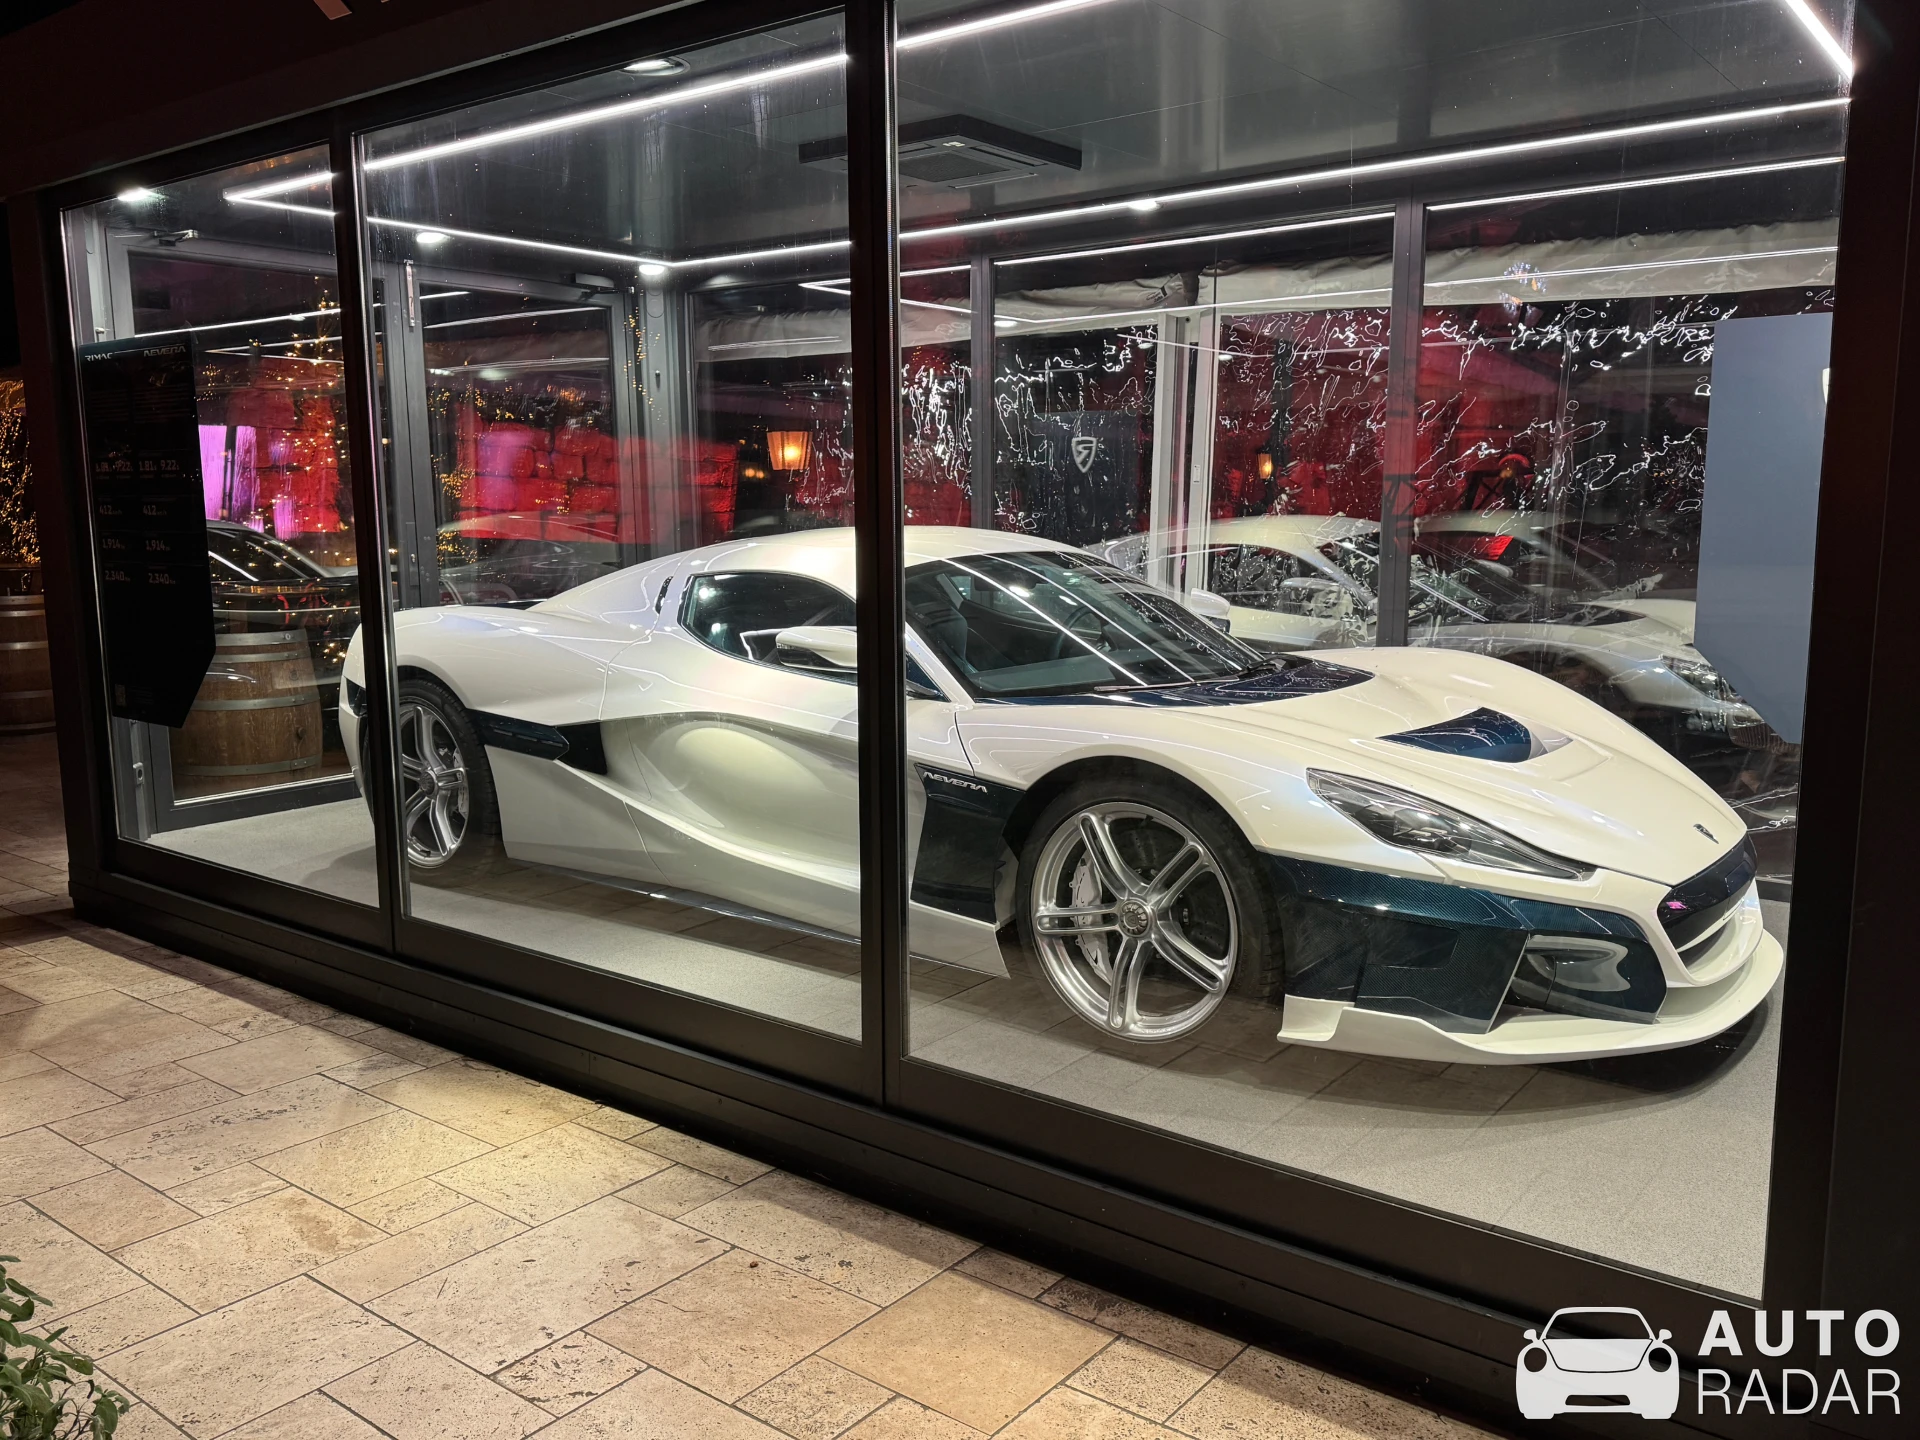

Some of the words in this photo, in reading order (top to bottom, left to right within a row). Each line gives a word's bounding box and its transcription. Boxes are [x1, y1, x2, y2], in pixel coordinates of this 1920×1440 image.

[143, 346, 186, 357] NEVERA
[85, 353, 113, 362] RIMAC
[923, 771, 988, 794] NEVERA
